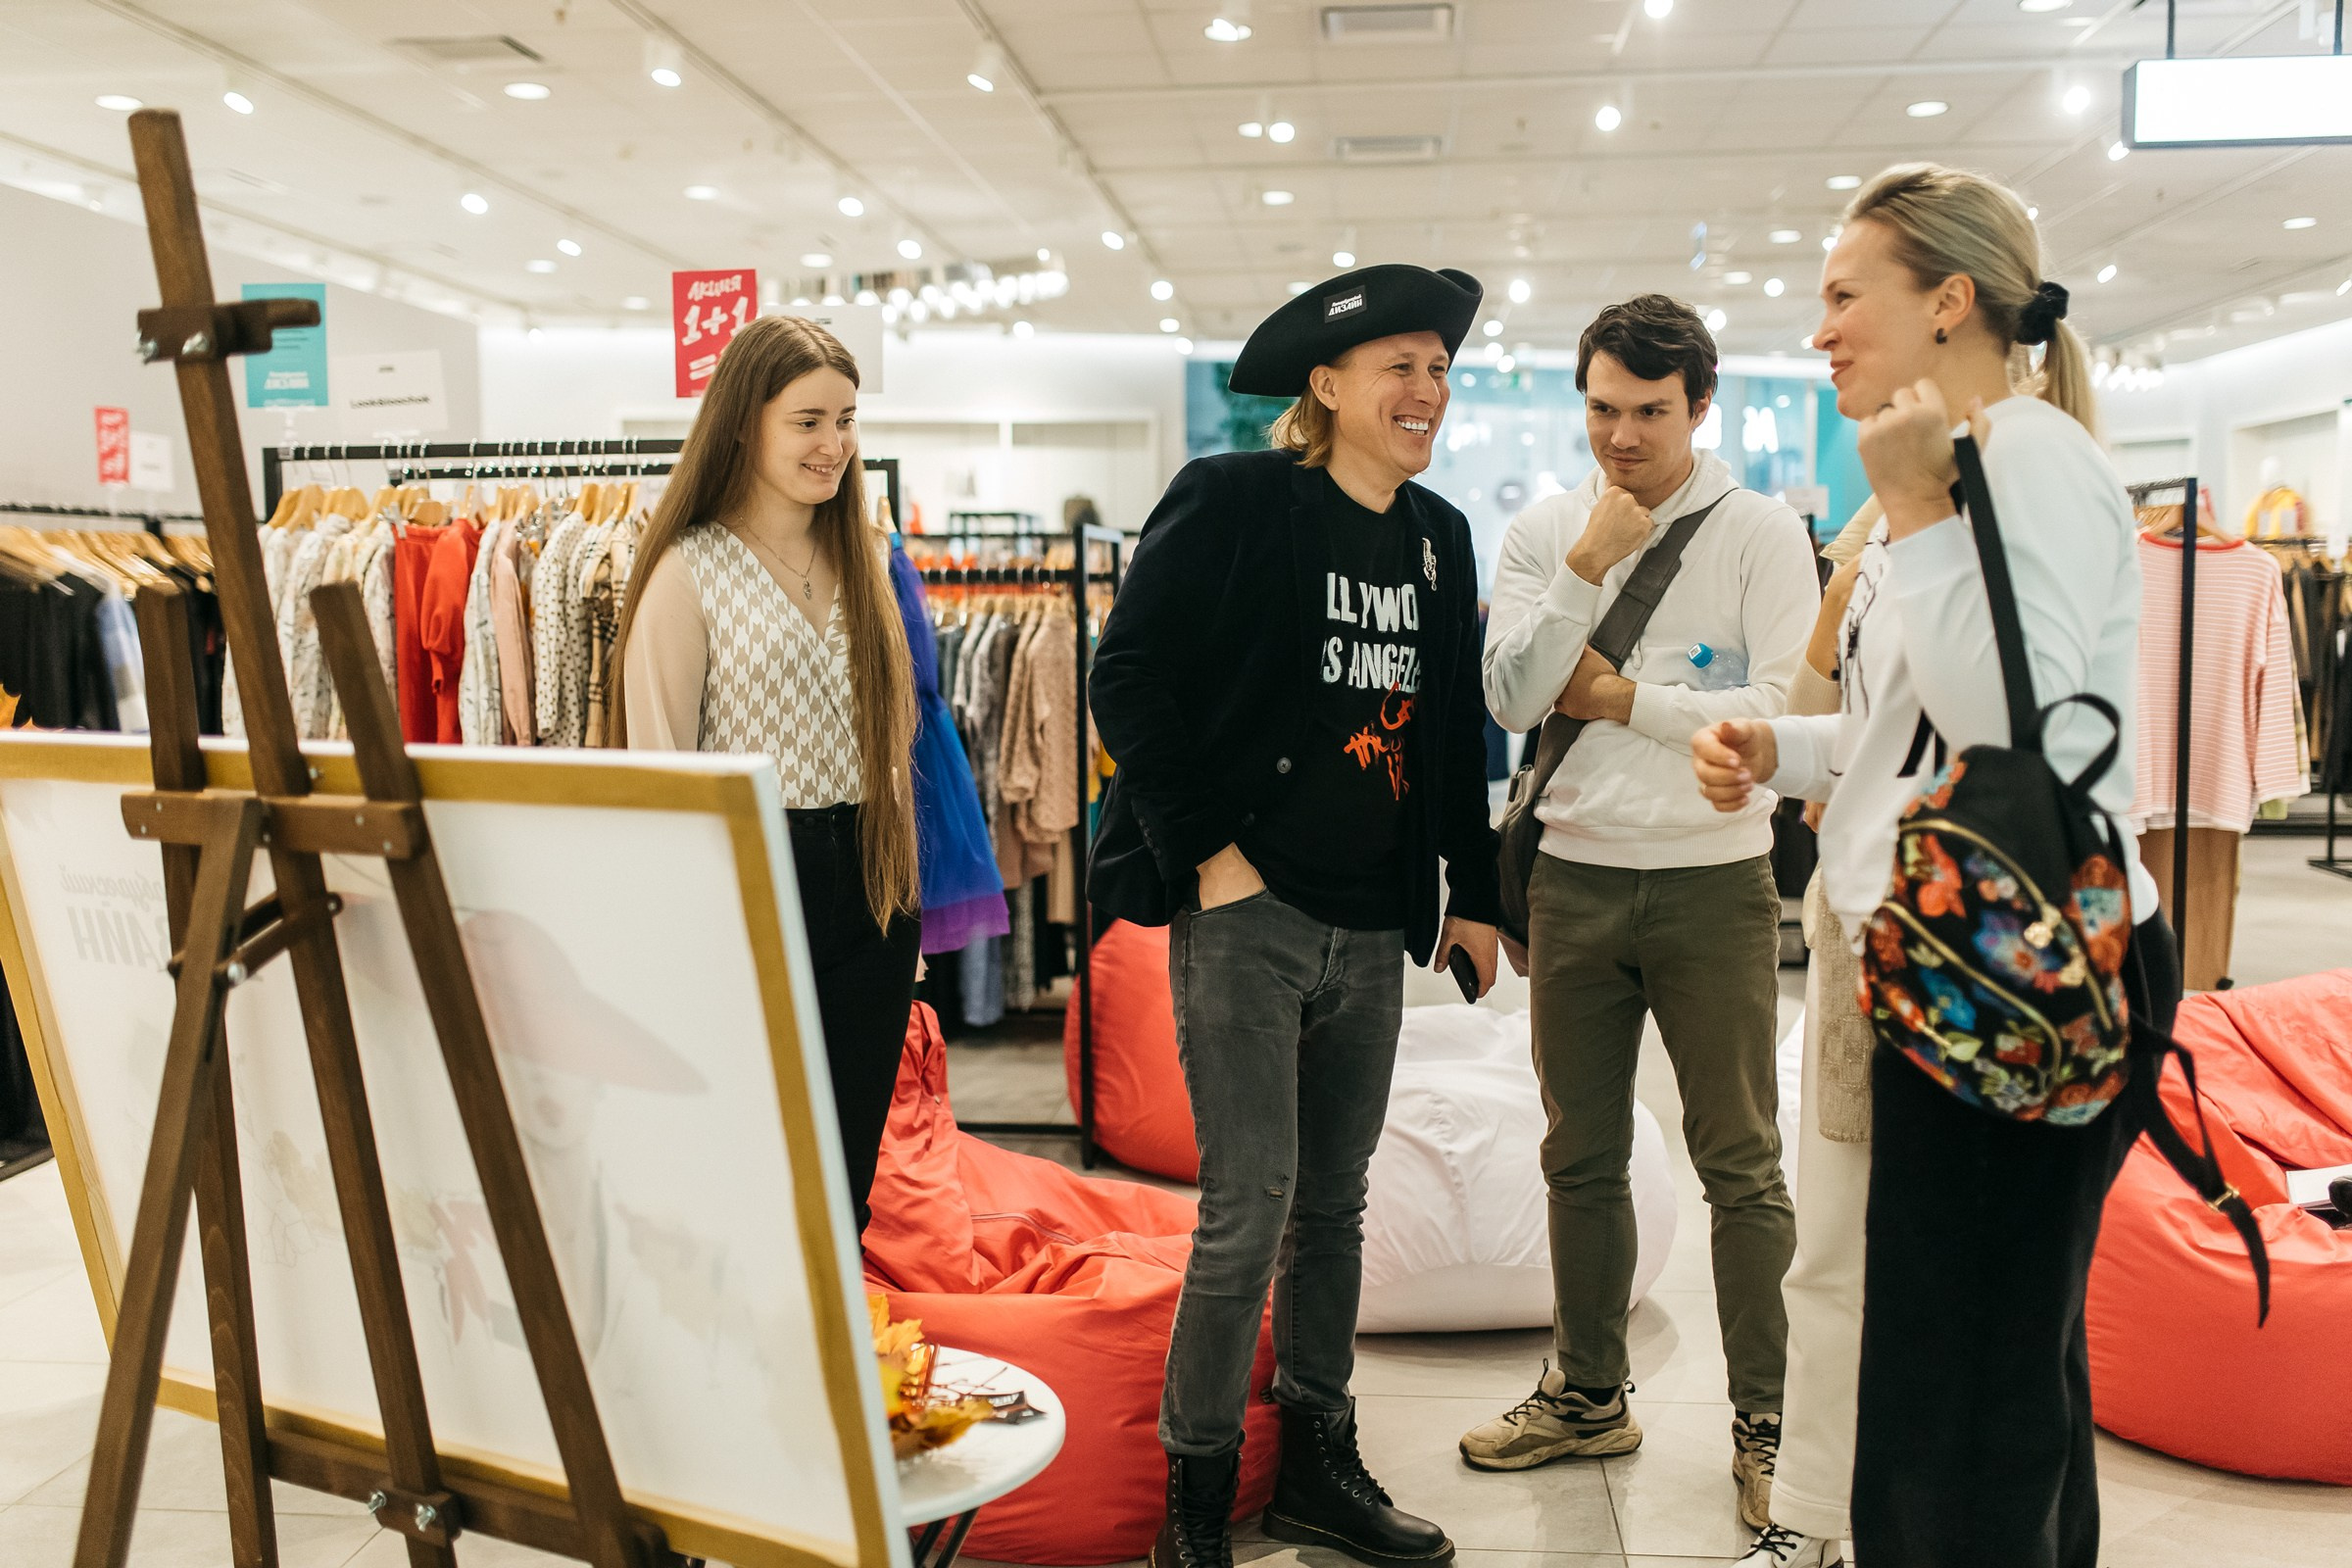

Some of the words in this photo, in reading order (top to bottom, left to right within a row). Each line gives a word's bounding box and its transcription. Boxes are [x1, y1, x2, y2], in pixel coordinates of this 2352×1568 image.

[687, 273, 743, 302] АКЦИЯ
[1328, 298, 1363, 317] ДИЗАЙН
[1327, 572, 1419, 632] LLYWO
[1320, 636, 1344, 683] S
